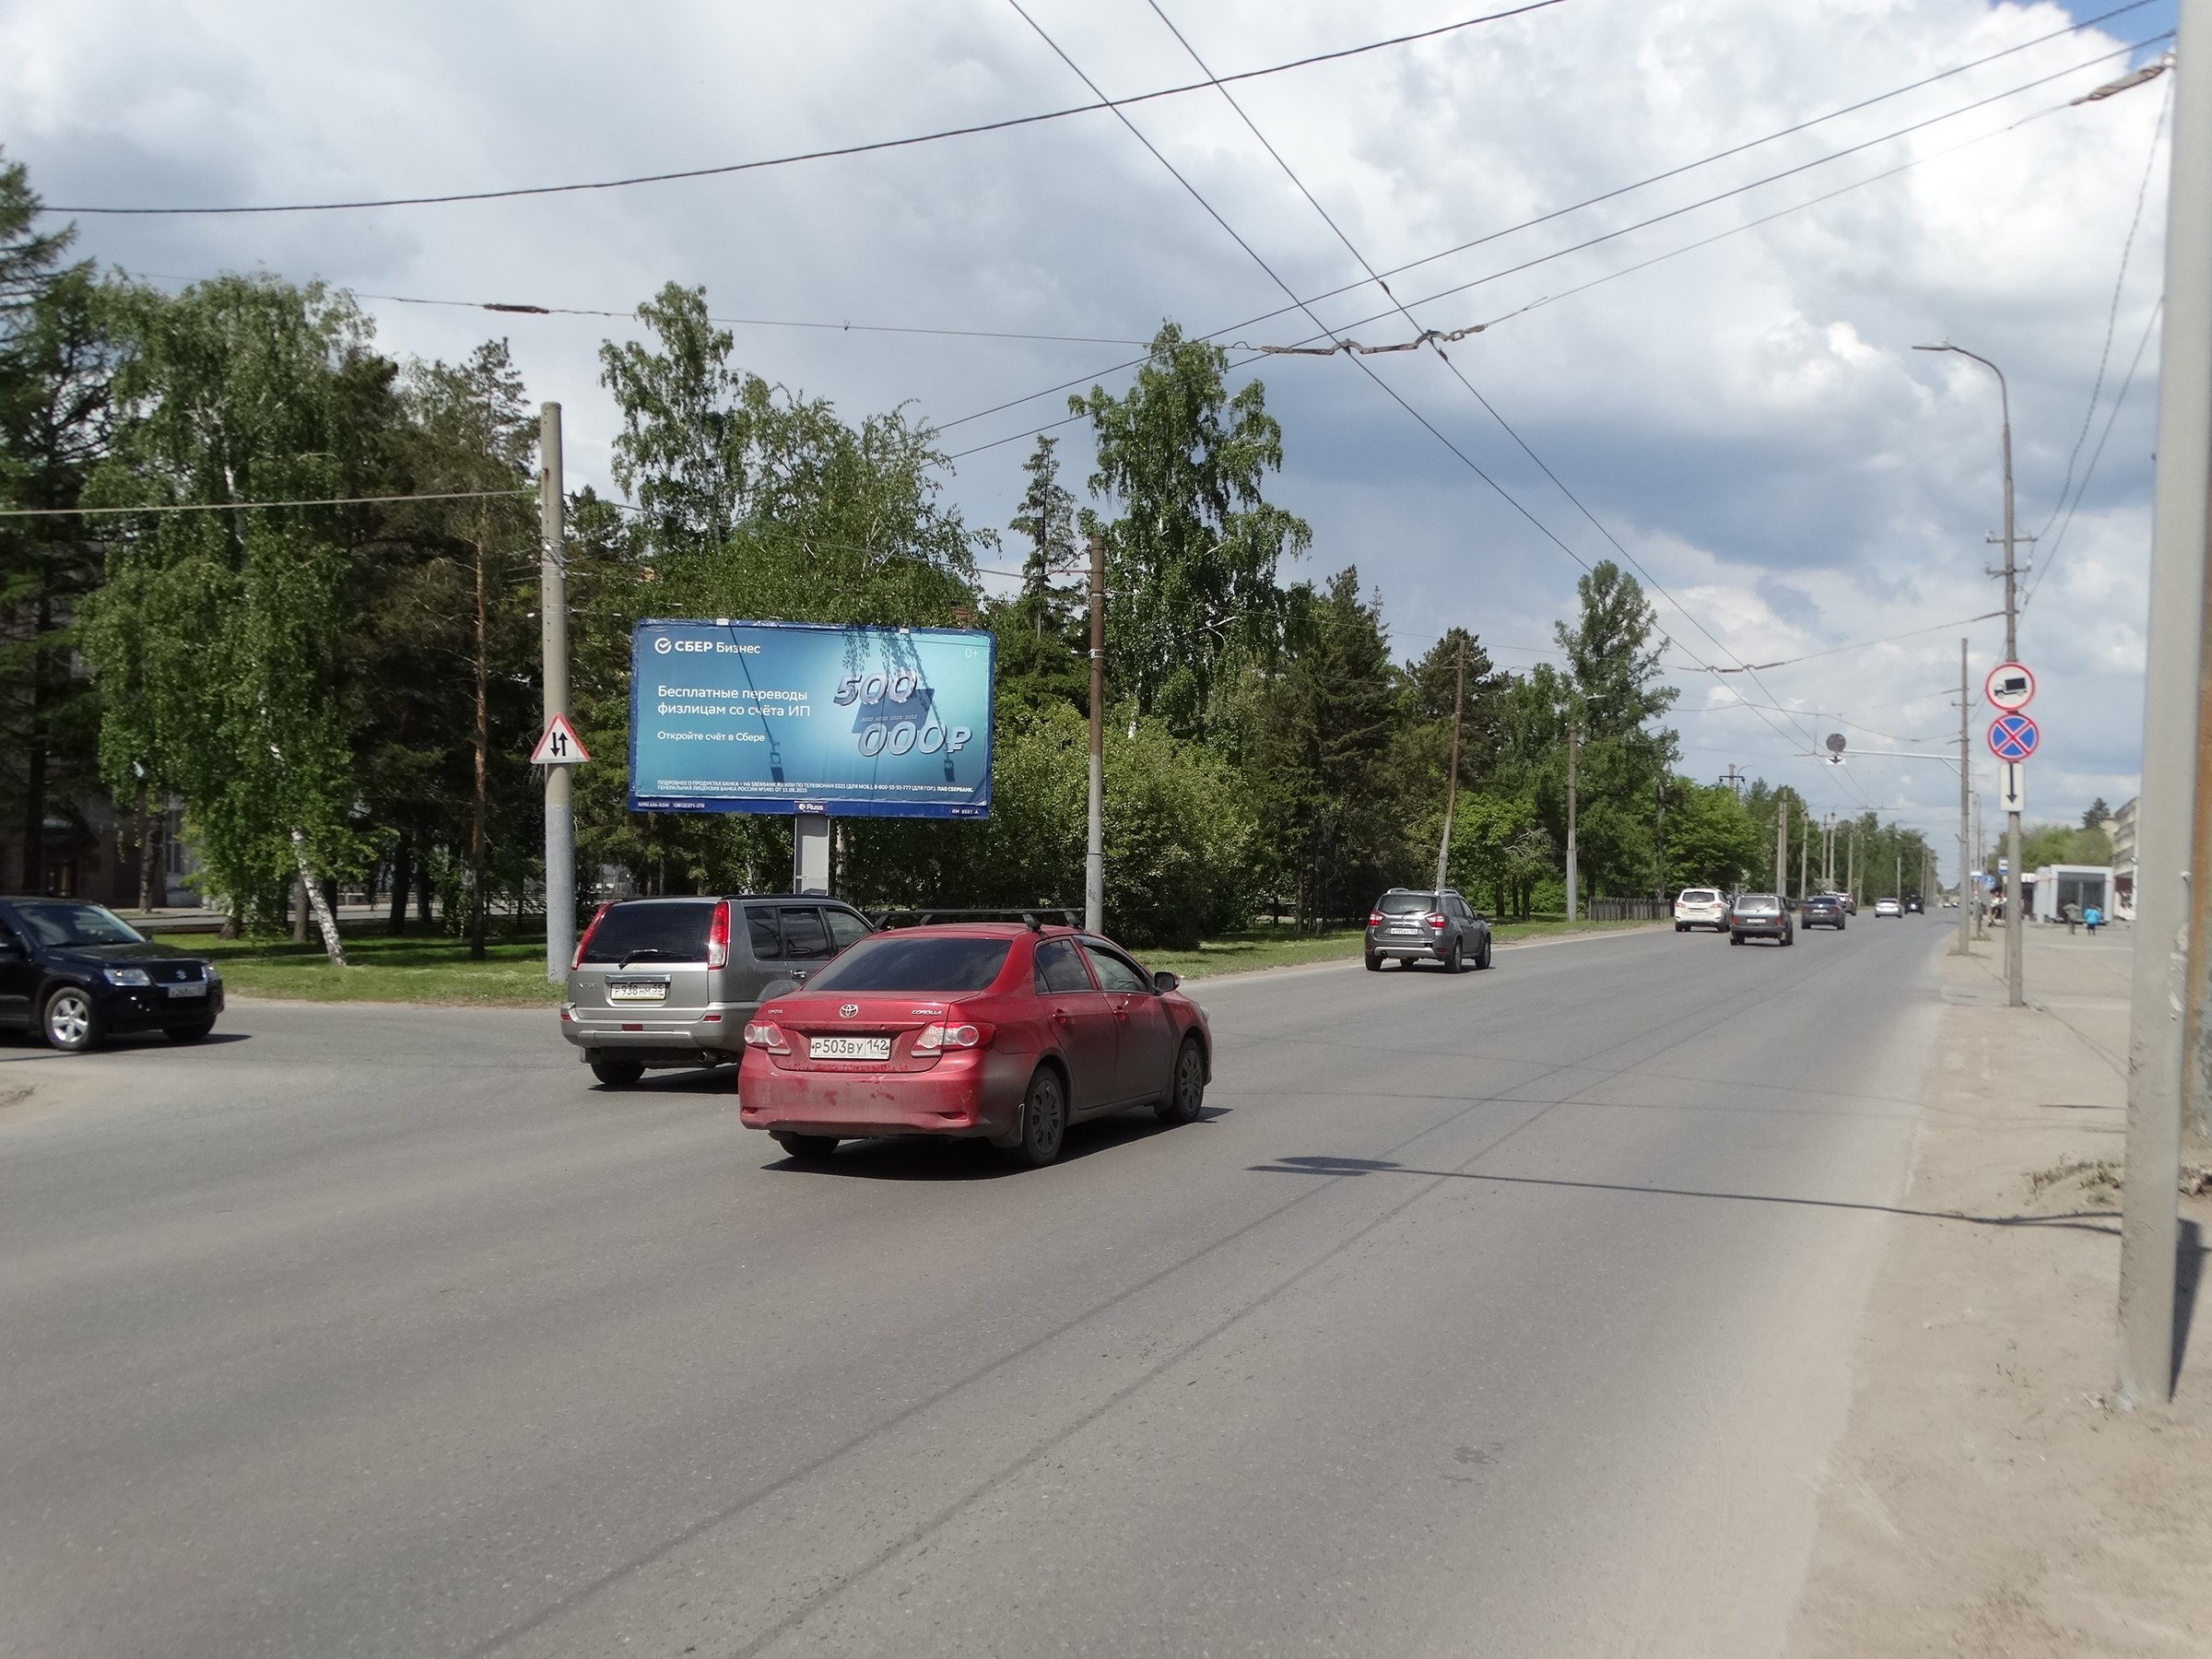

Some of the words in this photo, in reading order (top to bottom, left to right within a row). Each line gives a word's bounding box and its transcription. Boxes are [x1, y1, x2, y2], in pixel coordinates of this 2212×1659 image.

[675, 641, 712, 653] СБЕР
[716, 642, 761, 653] Бизнес
[965, 648, 979, 658] 0+
[658, 686, 738, 699] Бесплатные
[742, 690, 807, 701] переводы
[833, 669, 917, 706] 500
[657, 702, 725, 715] физлицам
[729, 706, 744, 715] со
[747, 705, 784, 716] счёта
[788, 706, 810, 717] ИП
[657, 731, 703, 741] Откройте
[705, 732, 725, 741] счёт
[736, 732, 765, 742] Сбере
[866, 1040, 888, 1051] 142
